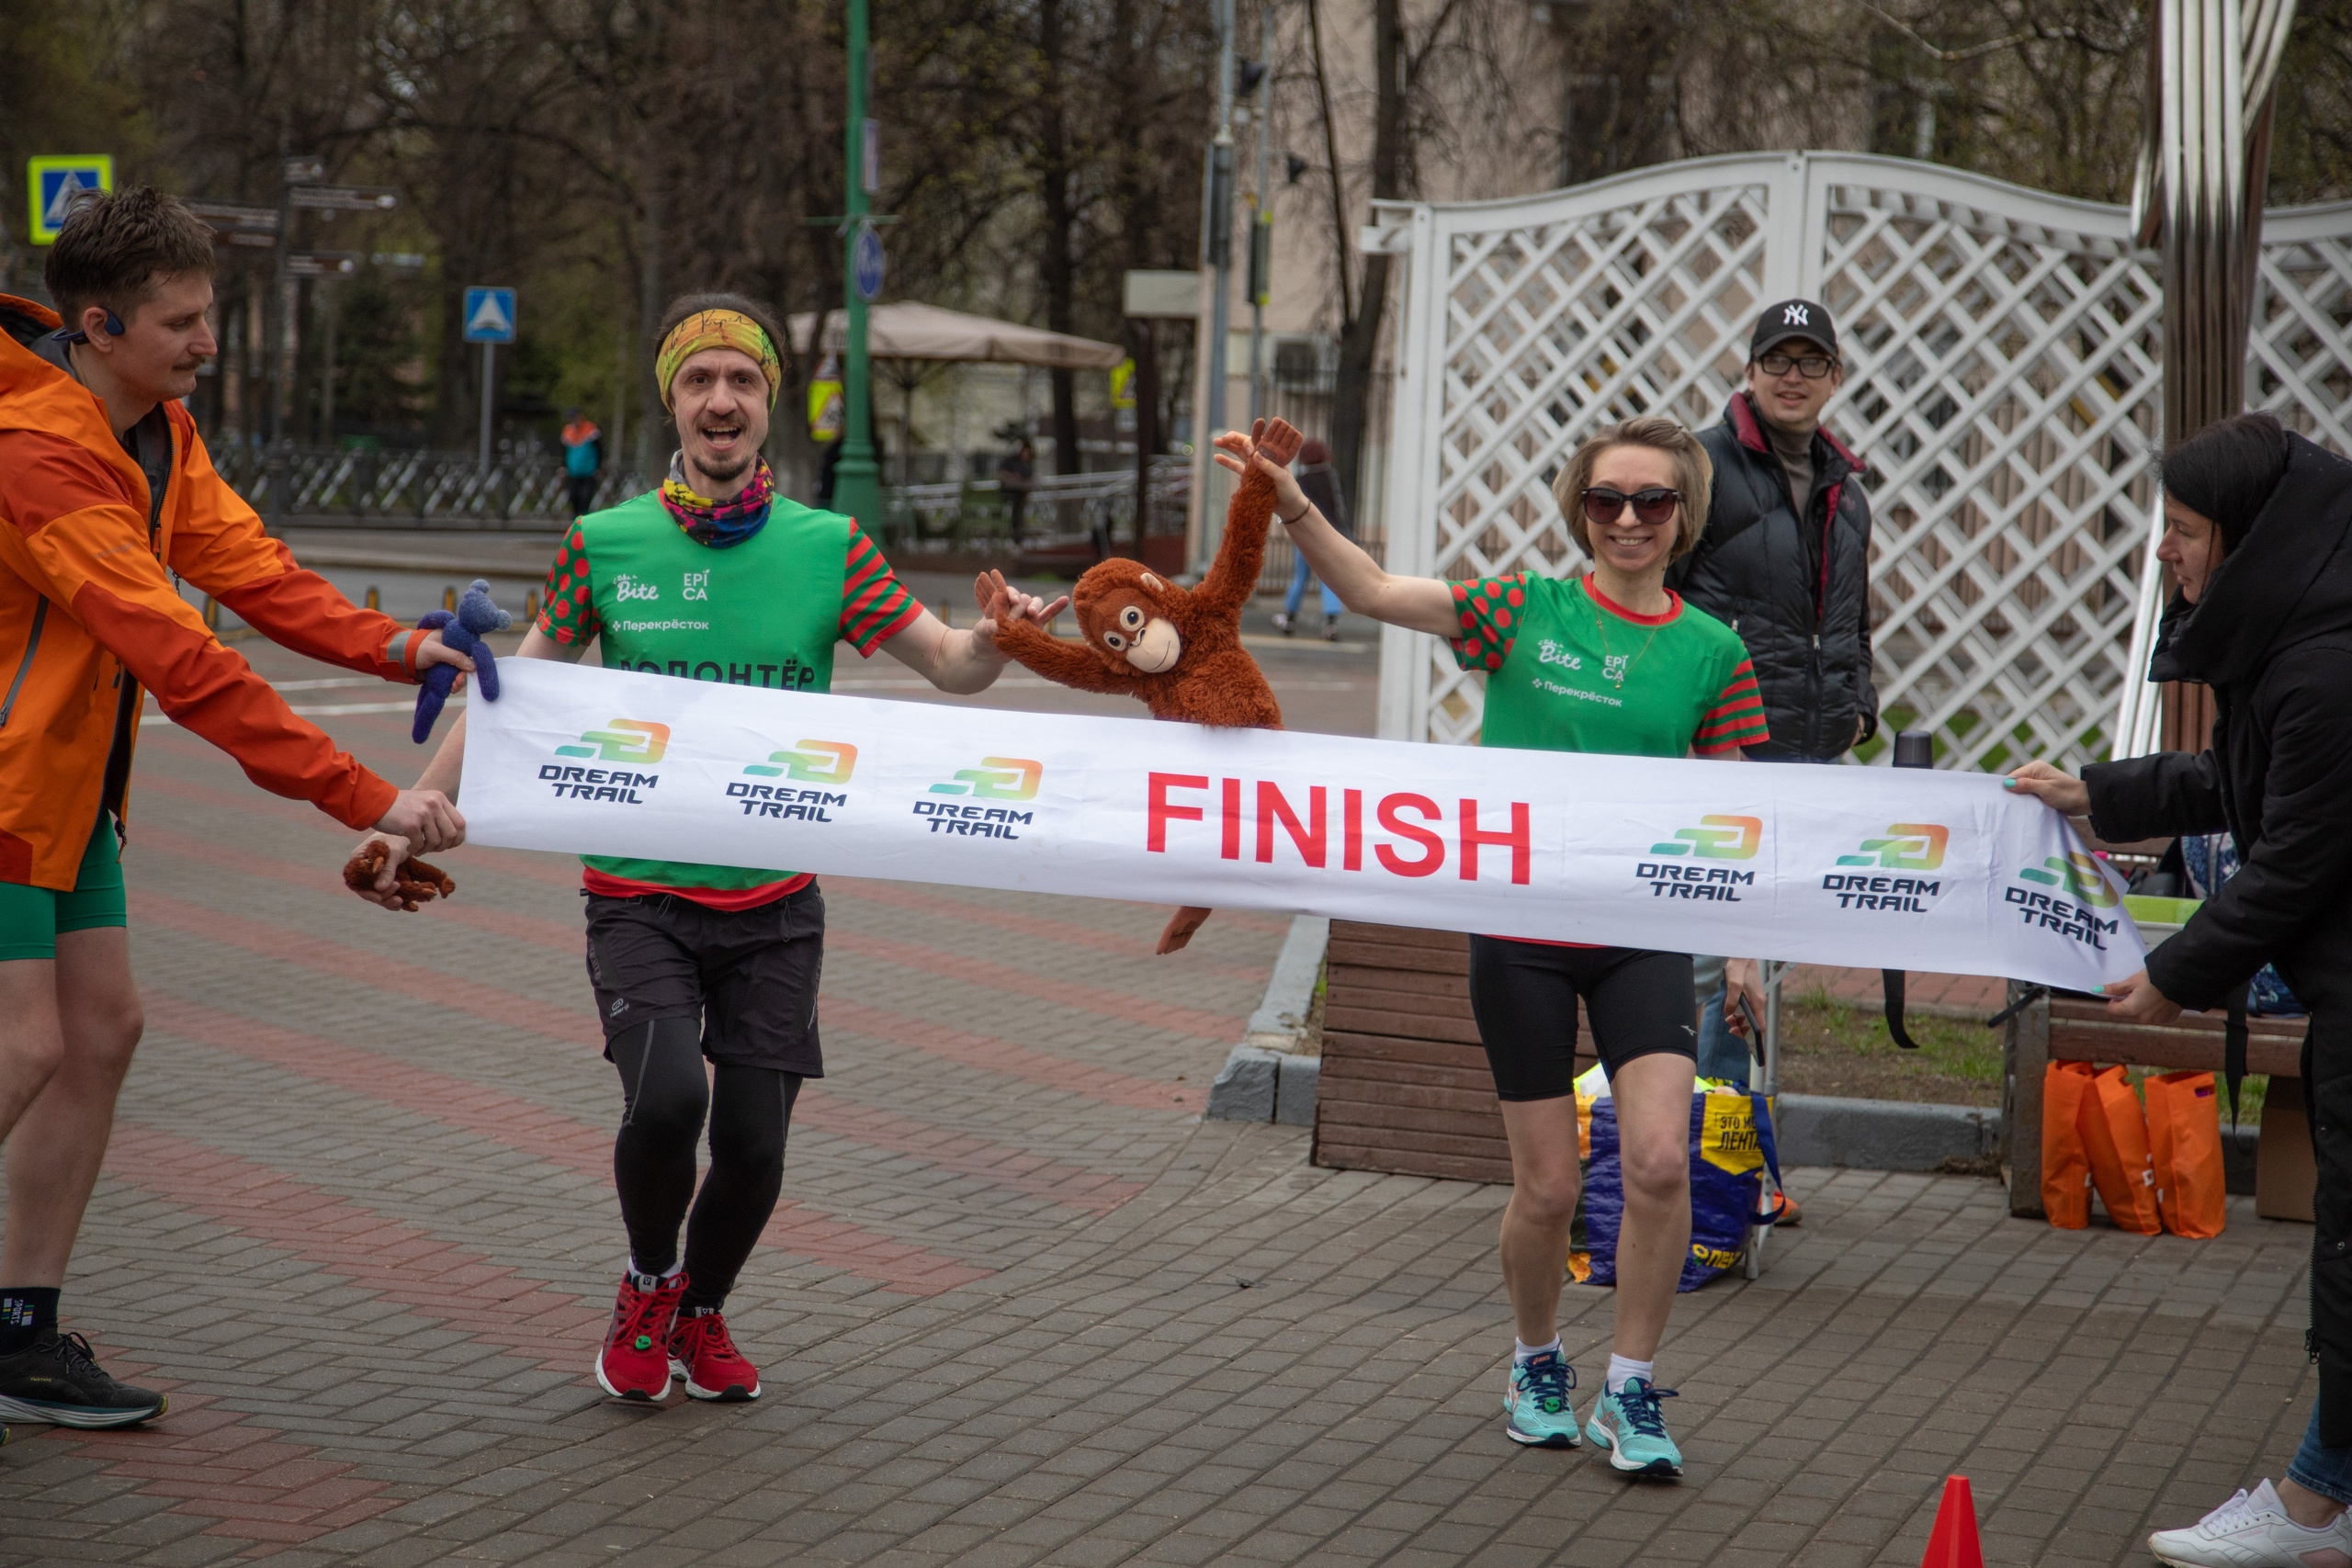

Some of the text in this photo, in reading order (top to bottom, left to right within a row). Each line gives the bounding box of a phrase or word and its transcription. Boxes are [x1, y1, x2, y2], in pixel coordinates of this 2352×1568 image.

[1783, 304, 1809, 326] NY
[616, 581, 660, 603] Bite
[683, 588, 708, 601] CA
[623, 618, 710, 633] Перекрёсток
[1539, 645, 1582, 671] Bite
[1602, 668, 1624, 682] CA
[1544, 681, 1623, 707] Перекрёсток
[538, 764, 660, 789] DREAM
[551, 783, 644, 805] TRAIL
[726, 782, 848, 807] DREAM
[739, 799, 834, 823] TRAIL
[912, 800, 1034, 825] DREAM
[926, 817, 1021, 840] TRAIL
[1147, 772, 1531, 886] FINISH
[1635, 863, 1756, 886] DREAM
[1823, 874, 1941, 897] DREAM
[1650, 880, 1743, 903] TRAIL
[1837, 892, 1929, 914] TRAIL
[2005, 886, 2120, 935] DREAM
[2019, 907, 2108, 952] TRAIL
[1720, 1116, 1740, 1130] ЭТО
[10, 1299, 24, 1325] SPORTS
